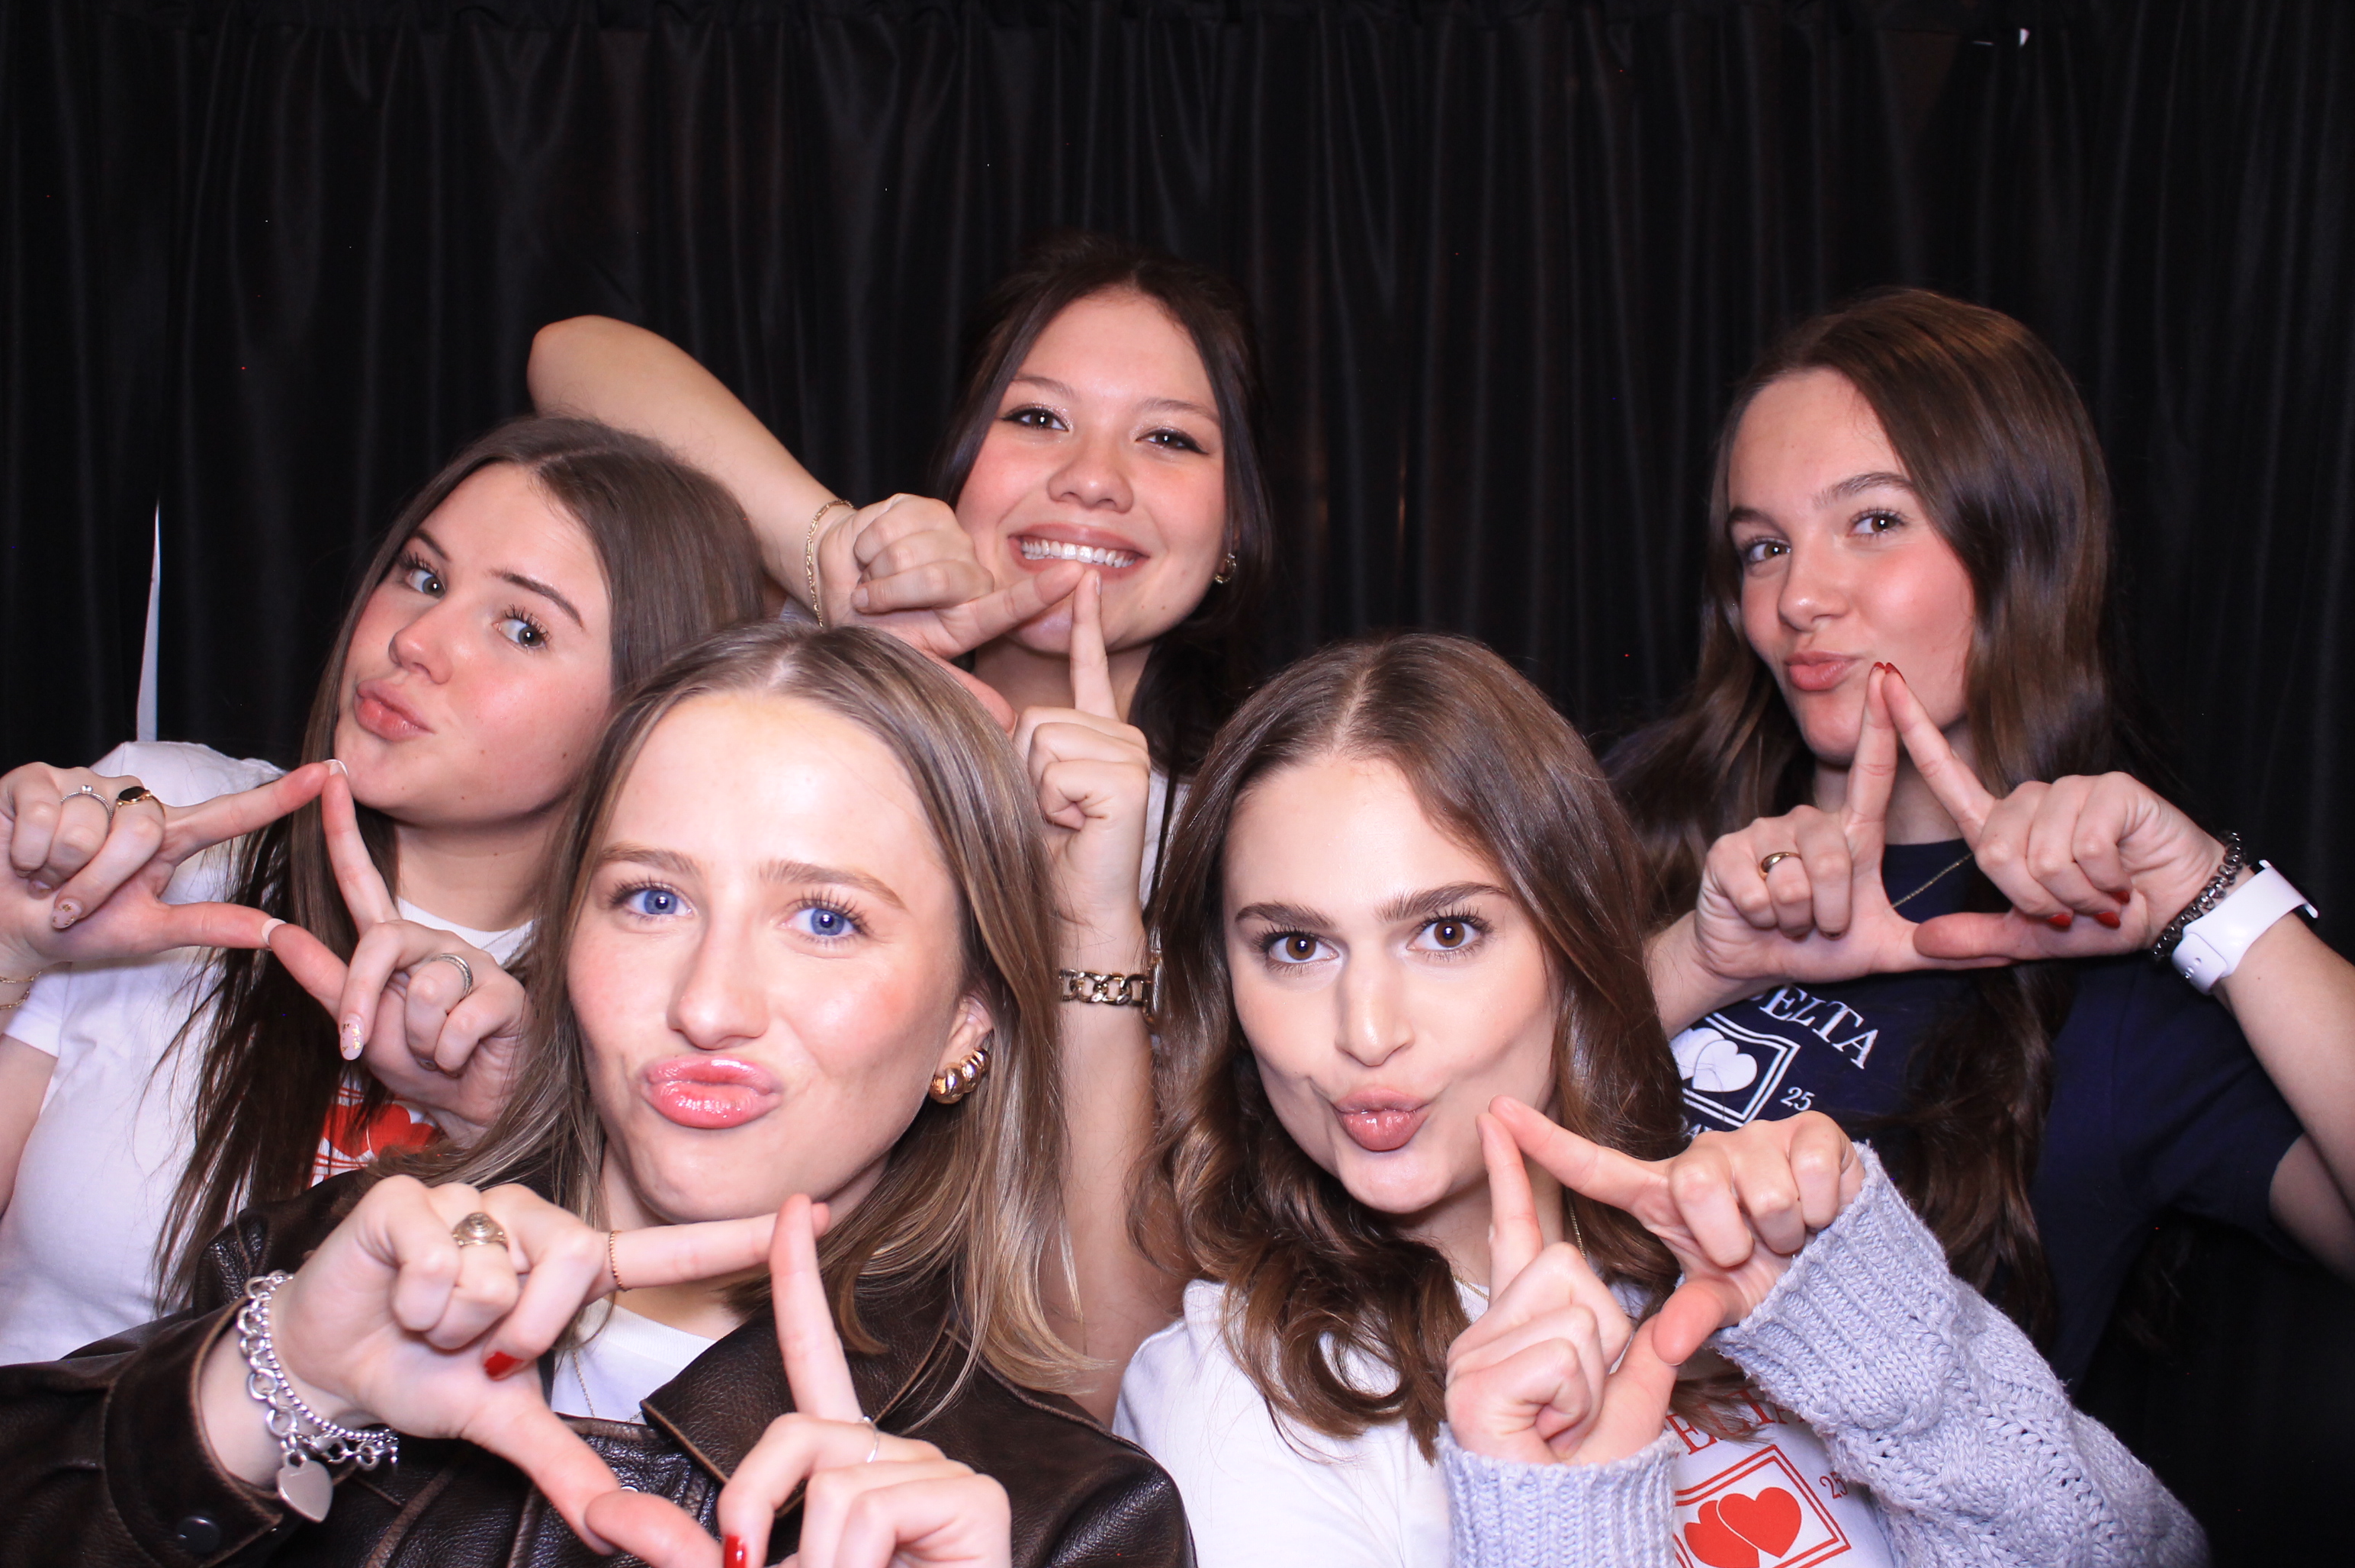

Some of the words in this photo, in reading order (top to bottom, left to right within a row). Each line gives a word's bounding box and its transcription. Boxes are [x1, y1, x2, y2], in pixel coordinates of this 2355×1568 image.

[1748, 985, 1878, 1069] ELTA
[1781, 1087, 1815, 1111] 25
[1819, 1471, 1848, 1499] 25
